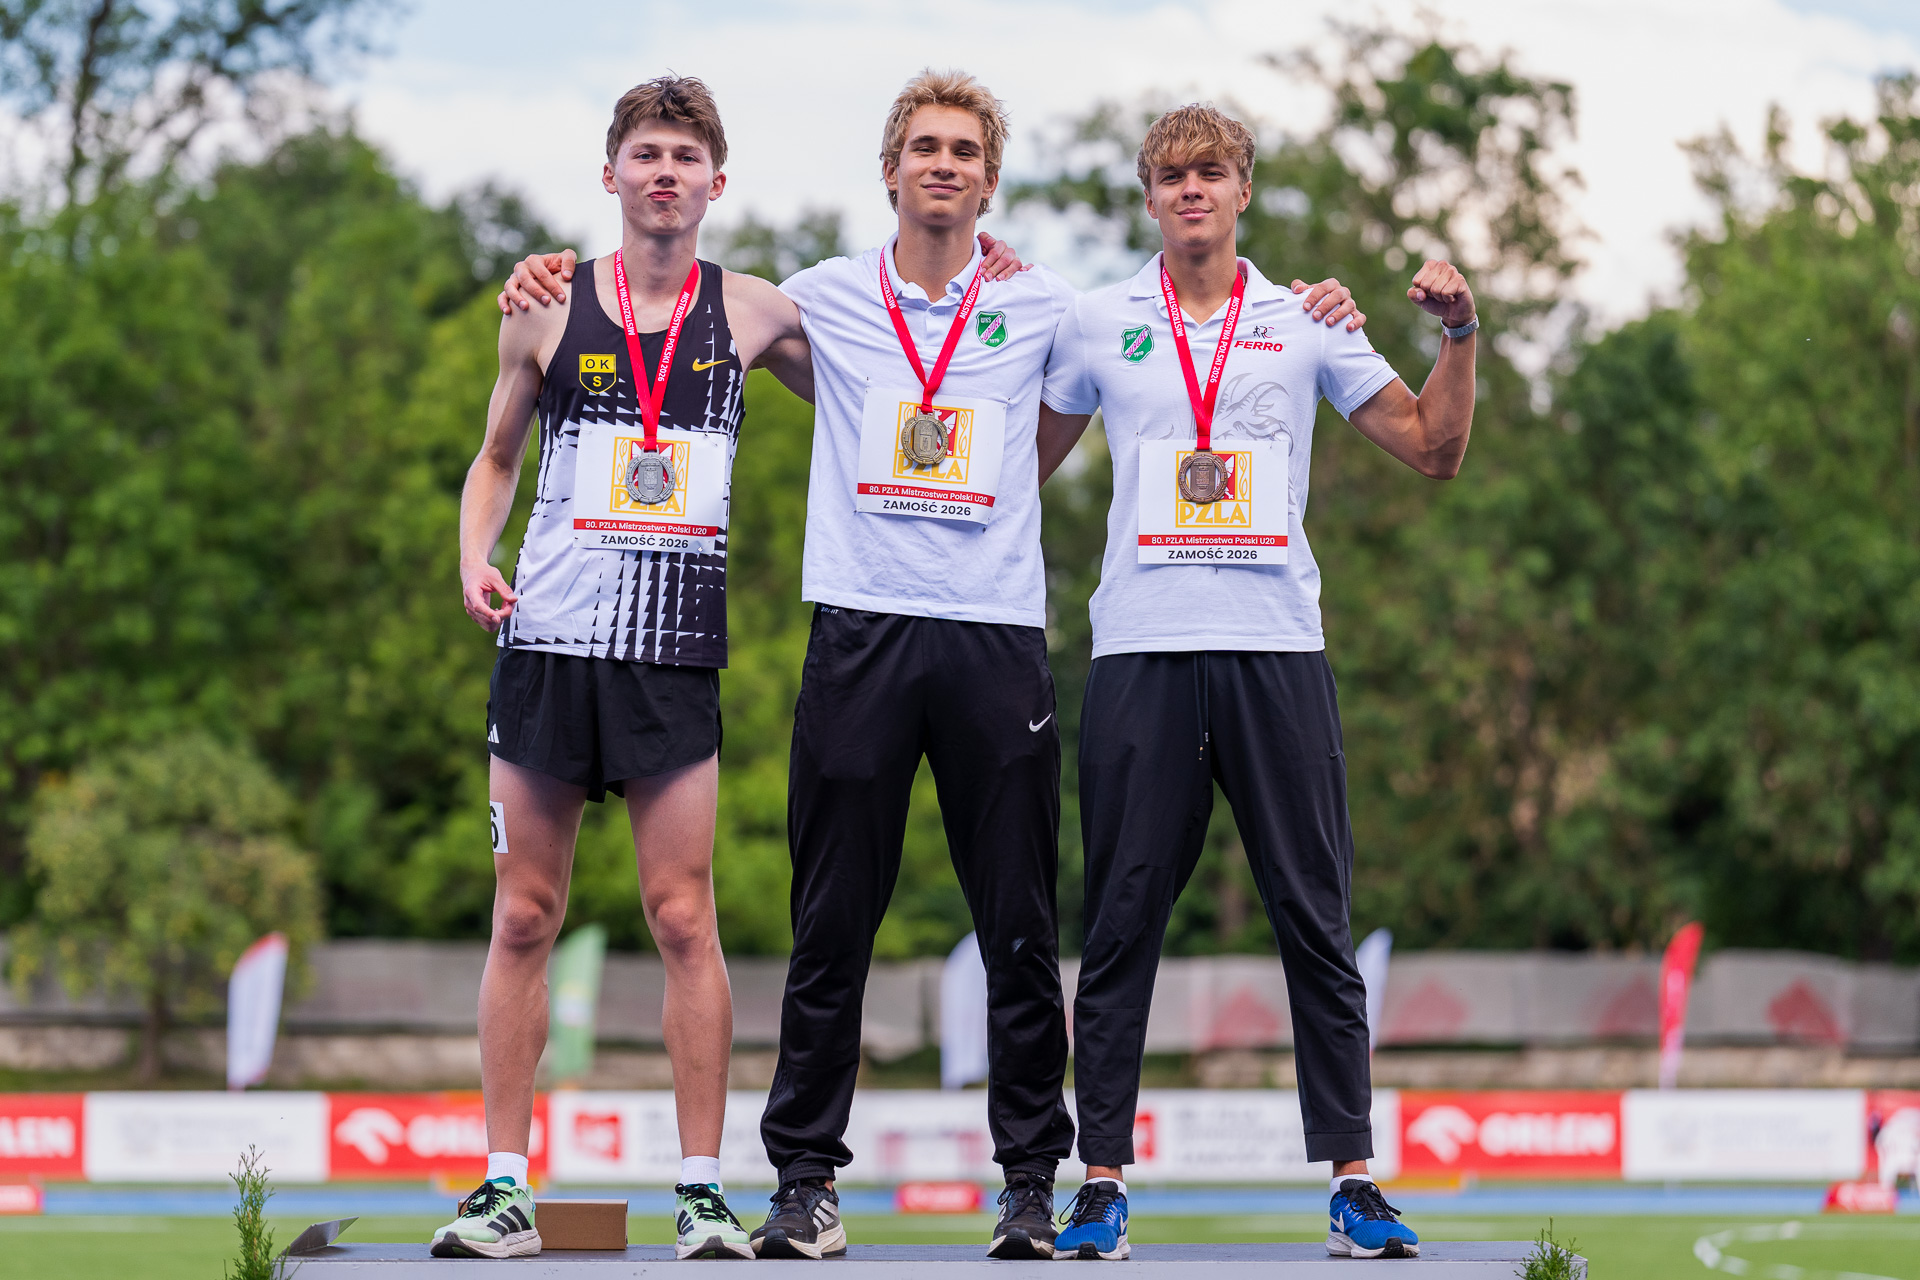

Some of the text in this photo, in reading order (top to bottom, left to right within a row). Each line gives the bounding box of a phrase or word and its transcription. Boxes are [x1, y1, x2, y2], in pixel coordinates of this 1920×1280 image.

[619, 286, 635, 335] MISTRZOSTWA
[1166, 290, 1184, 337] MISTRZOSTWA
[658, 291, 690, 381] MISTRZOSTWA POLSKI 2026
[1209, 296, 1240, 383] MISTRZOSTWA POLSKI 2026
[1234, 340, 1283, 352] FERRO
[868, 485, 988, 504] 80. PZLA Mistrzostwa Polski U20
[883, 499, 972, 516] ZAMOŚĆ 2026
[1179, 502, 1247, 524] PZLA
[585, 520, 707, 535] 80. PZLA Mistrzostwa Polski U20
[600, 534, 689, 549] ZAMOŚĆ 2026
[1151, 536, 1275, 545] 80. PZLA Mistrzostwa Polski U20
[1168, 547, 1258, 560] ZAMOŚĆ 2026
